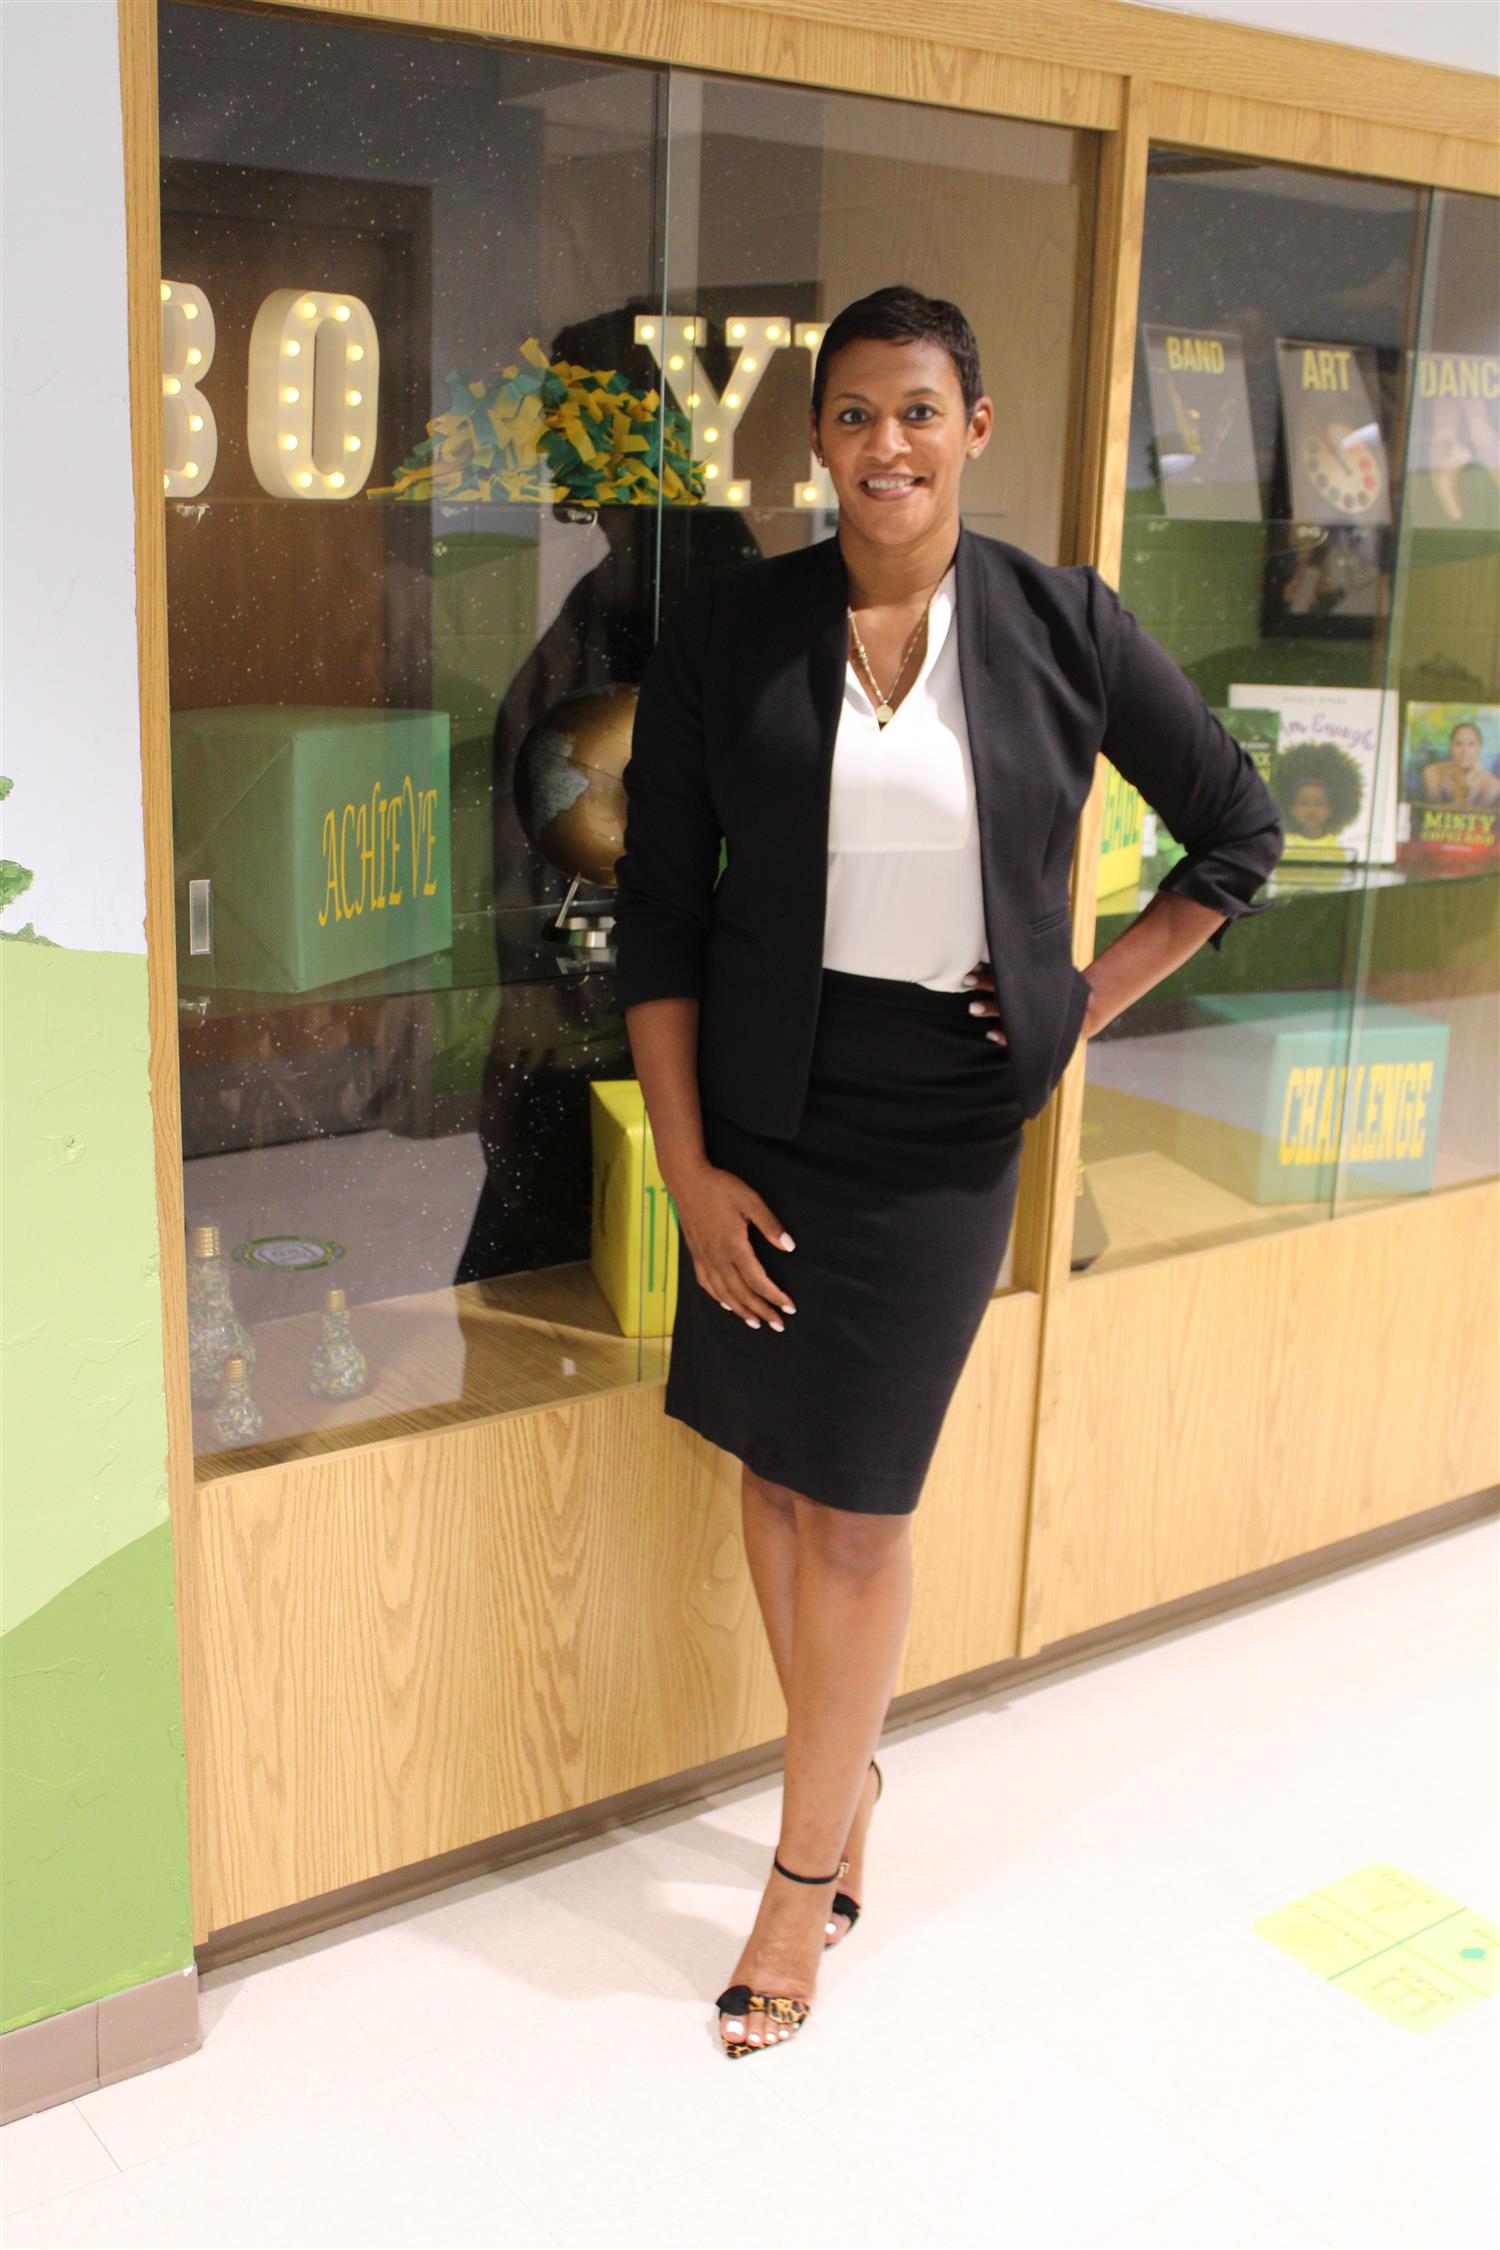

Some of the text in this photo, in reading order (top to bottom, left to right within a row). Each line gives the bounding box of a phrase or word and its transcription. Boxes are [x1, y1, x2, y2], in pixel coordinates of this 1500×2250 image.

[1166, 335, 1225, 375] BAND
[1302, 348, 1352, 392] ART
[1423, 809, 1497, 834] MISTY
[318, 775, 437, 927] ACHIEVE
[1279, 1060, 1434, 1166] CHALLENGE
